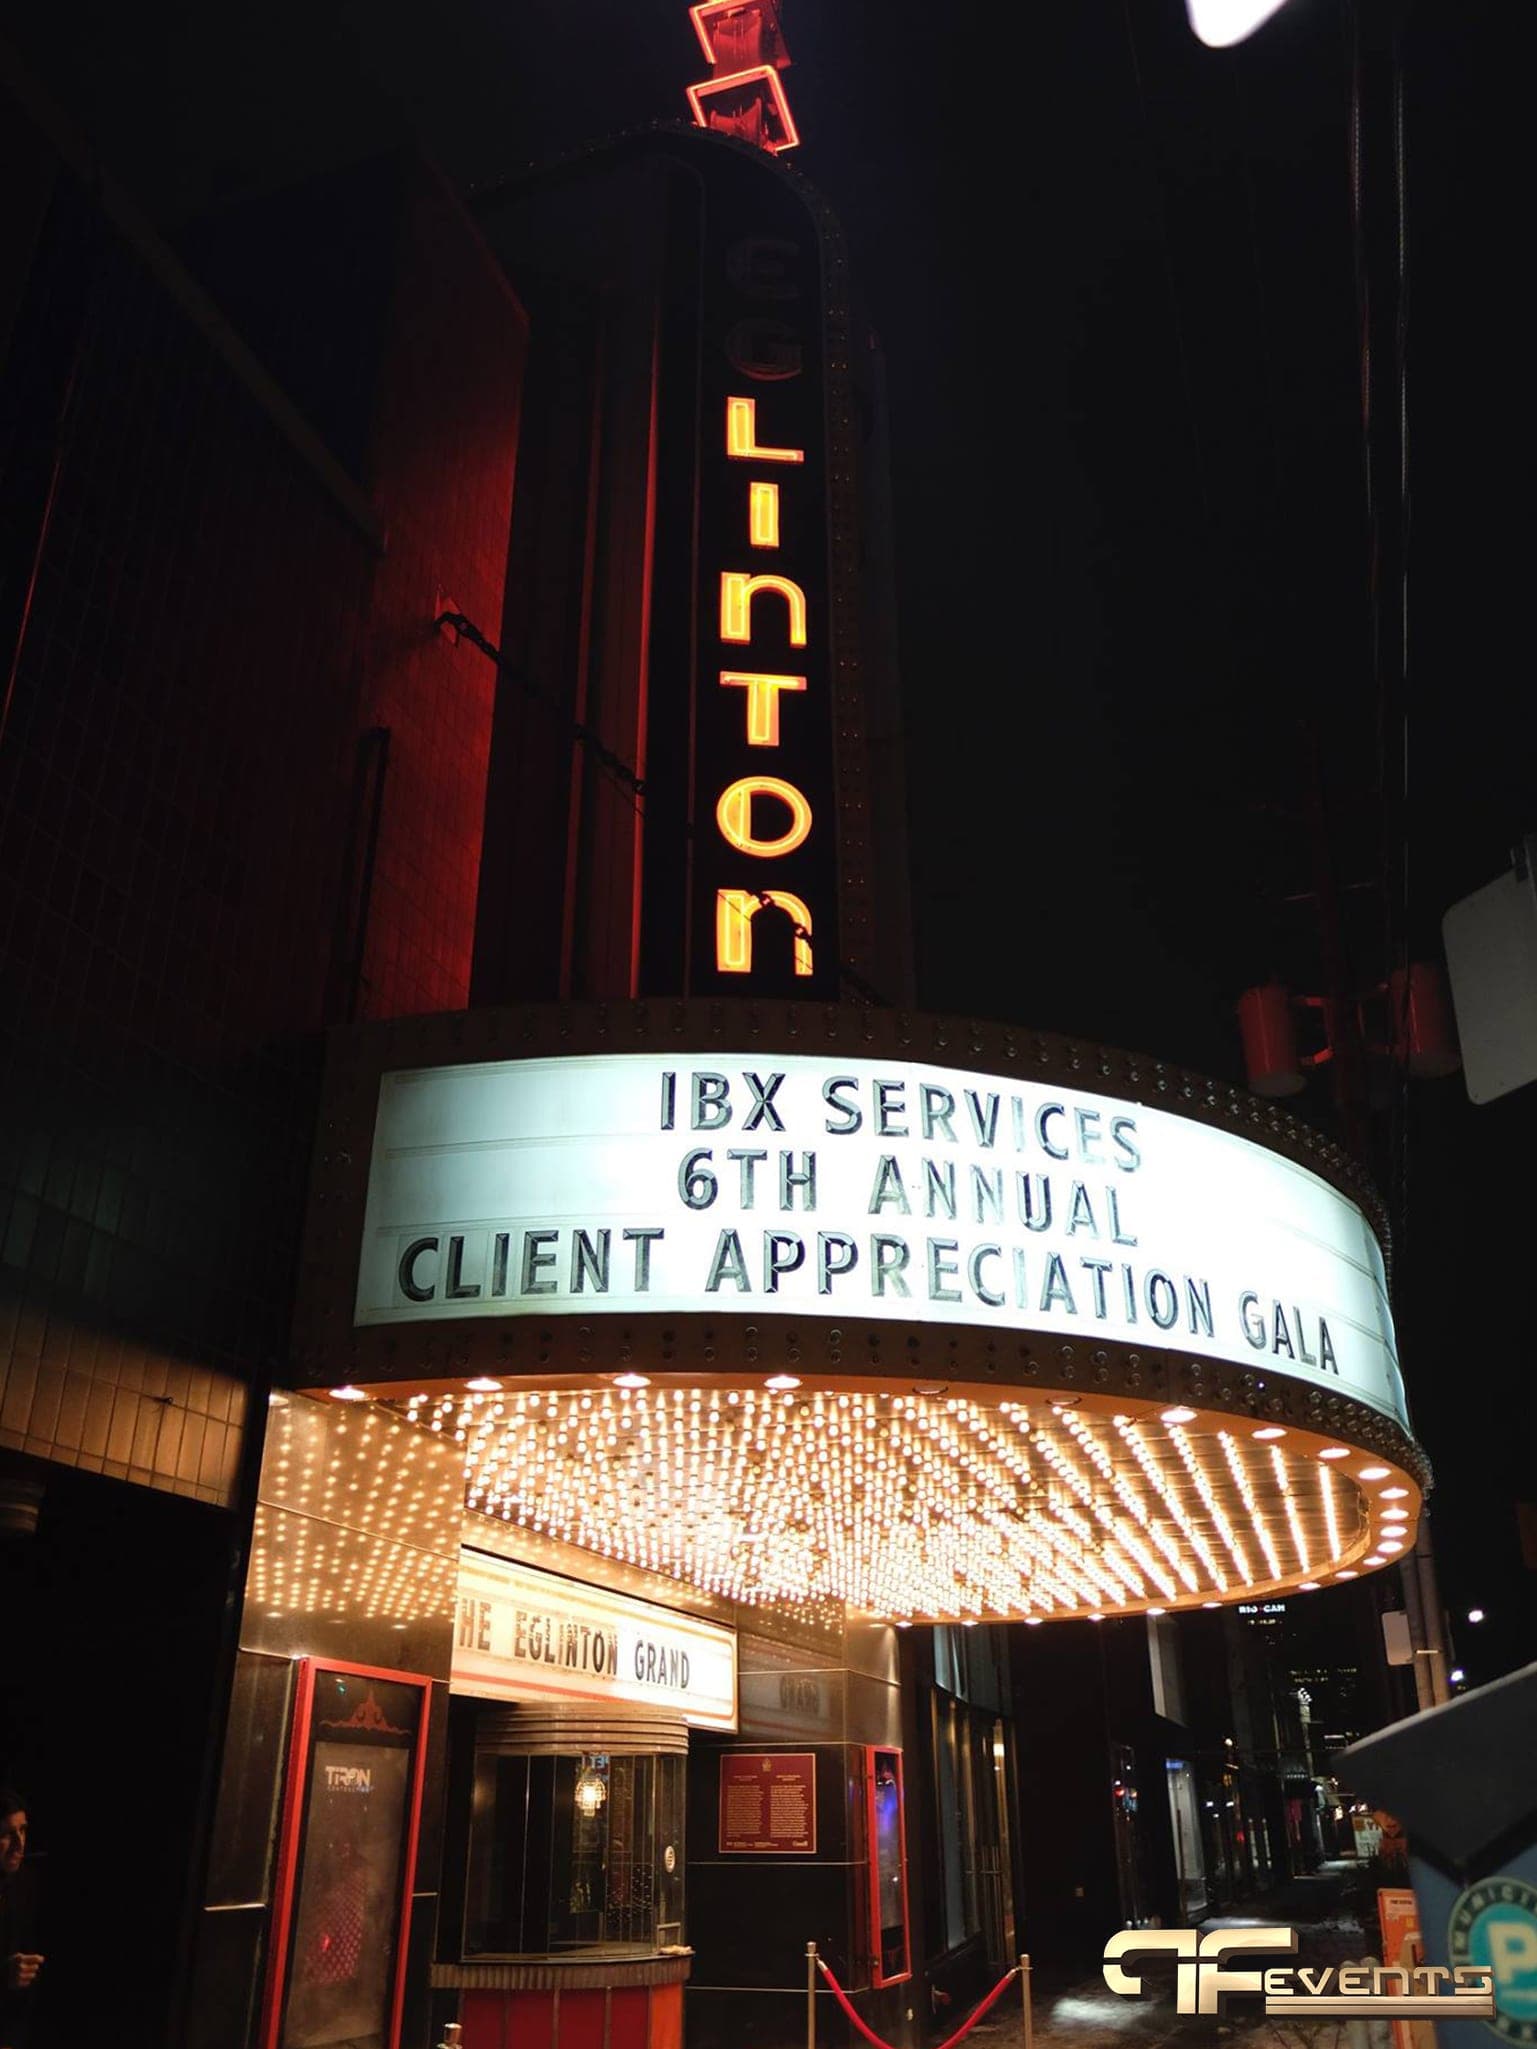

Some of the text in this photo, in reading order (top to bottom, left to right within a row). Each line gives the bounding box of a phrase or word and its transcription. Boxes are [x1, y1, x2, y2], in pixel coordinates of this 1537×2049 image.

[660, 1071, 1142, 1173] IBX SERVICES
[677, 1147, 1138, 1247] 6TH ANNUAL
[398, 1227, 1340, 1375] CLIENT APPRECIATION GALA
[514, 1610, 618, 1676] EGLINTON
[635, 1640, 690, 1689] GRAND
[325, 1765, 371, 1786] TRON
